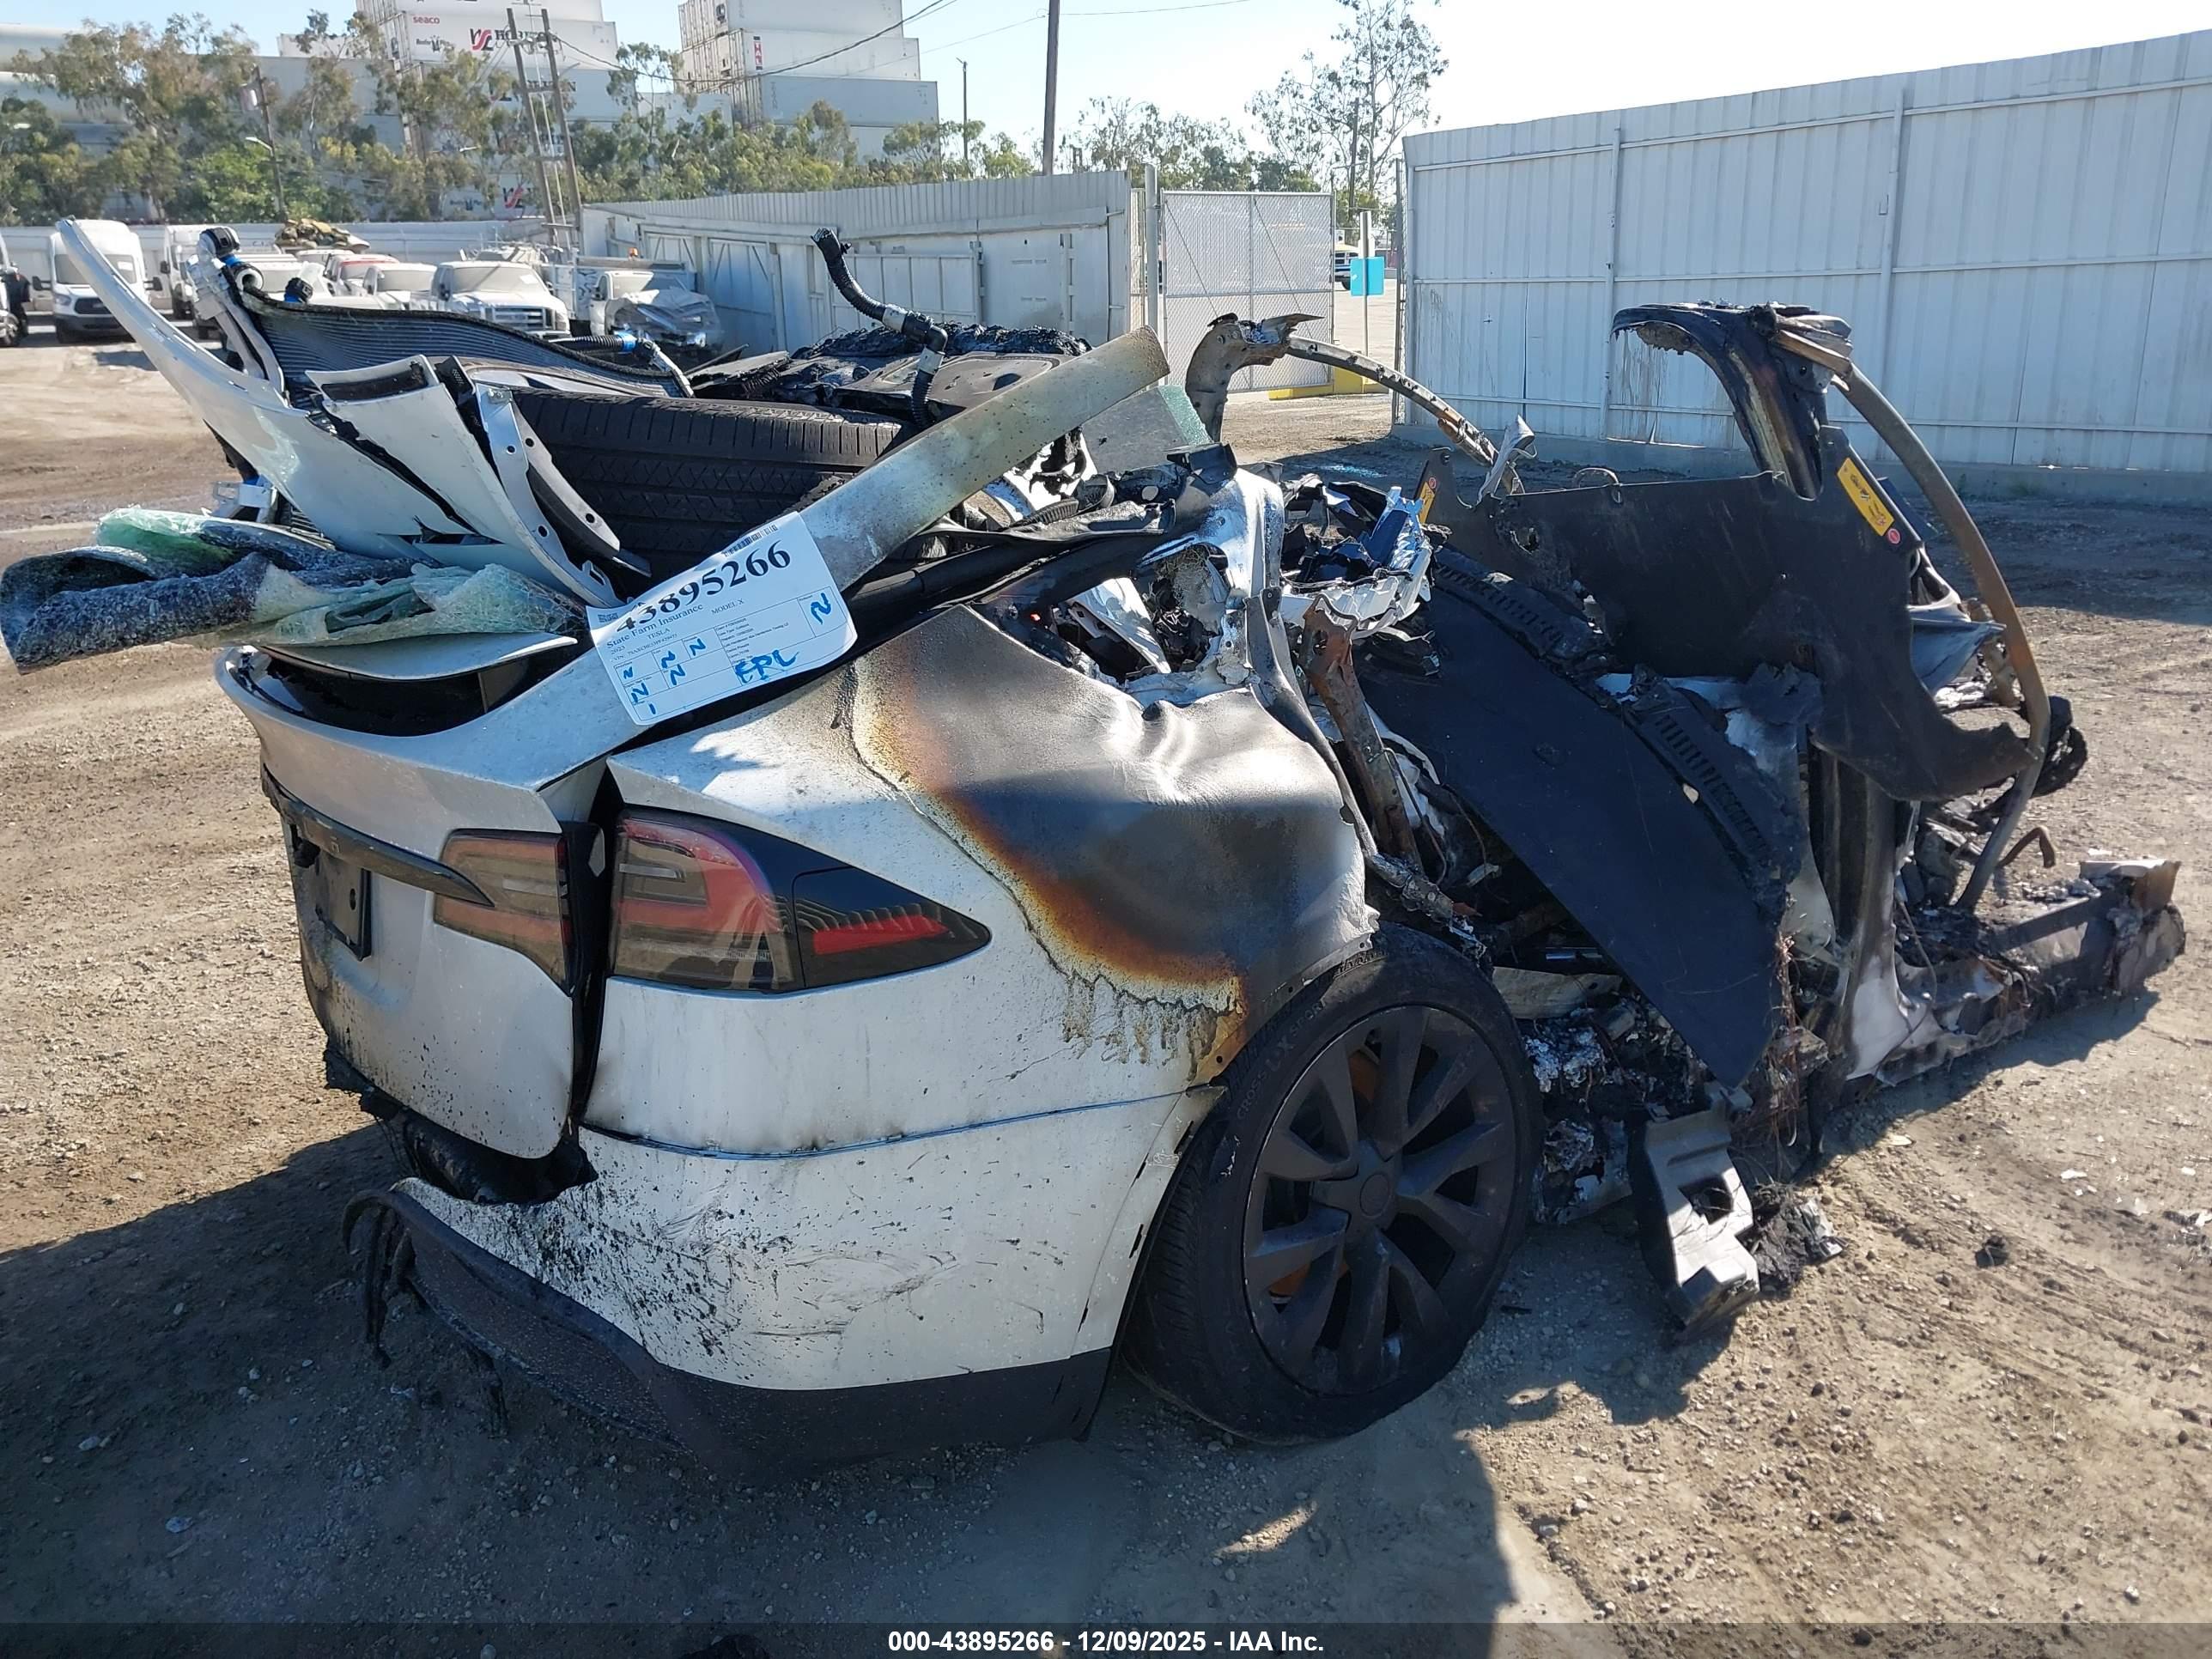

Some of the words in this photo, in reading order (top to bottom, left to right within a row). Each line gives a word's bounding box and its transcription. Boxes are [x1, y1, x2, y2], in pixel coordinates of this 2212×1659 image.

[413, 15, 440, 24] seaco
[617, 540, 791, 632] 43895266
[606, 634, 630, 648] State
[631, 623, 657, 636] Farm
[659, 604, 704, 626] Insurance
[647, 628, 671, 641] TESLA
[711, 603, 736, 615] MODEL
